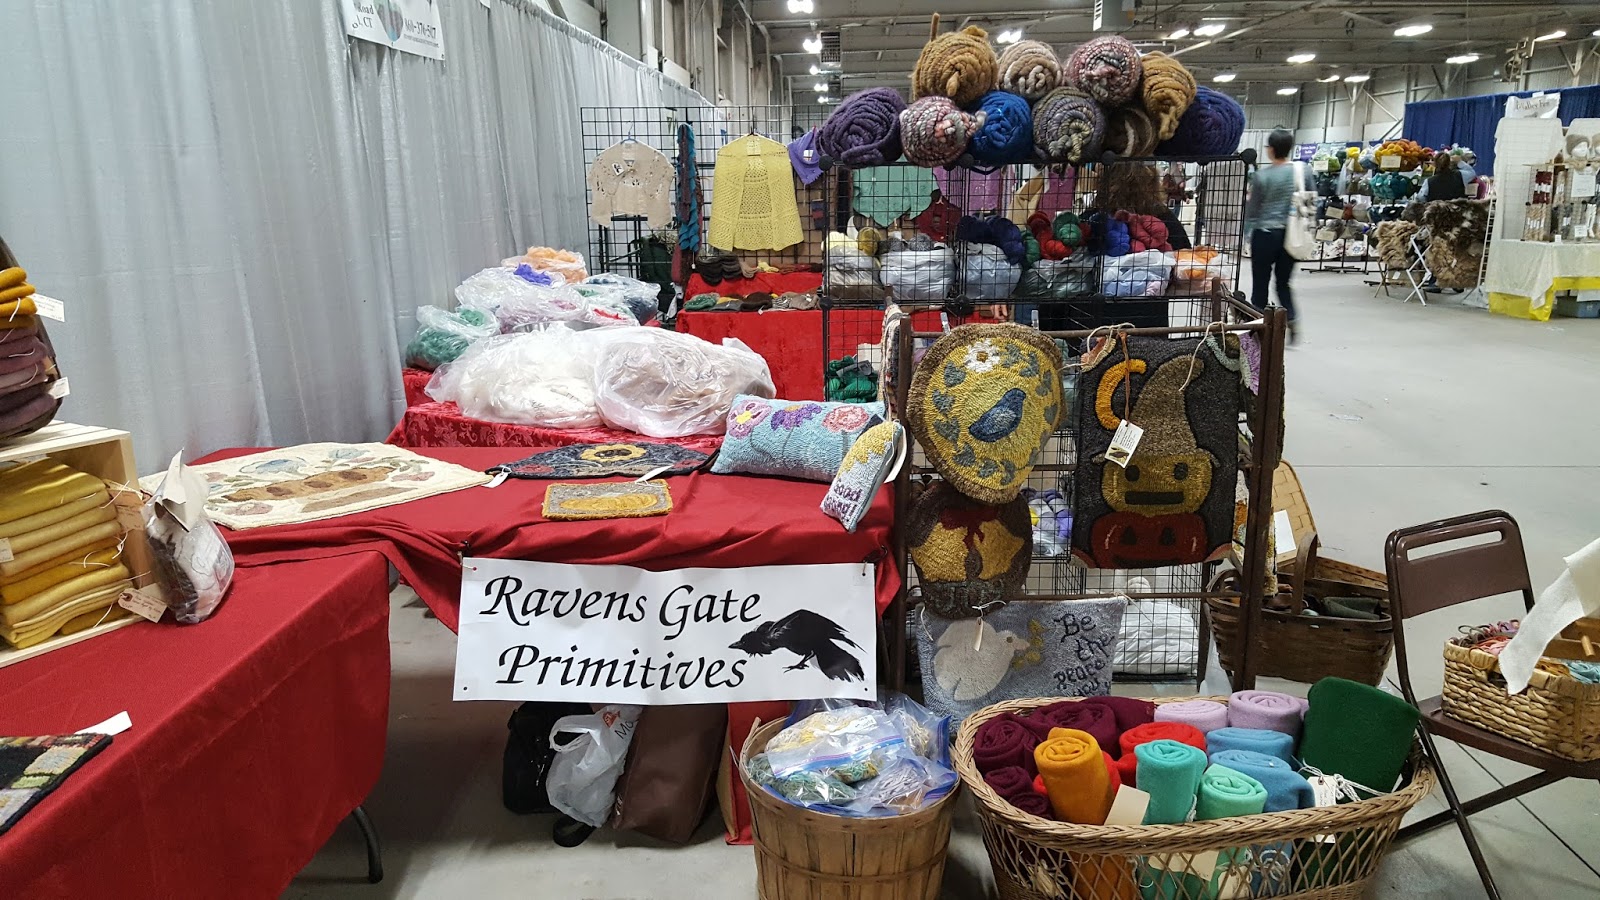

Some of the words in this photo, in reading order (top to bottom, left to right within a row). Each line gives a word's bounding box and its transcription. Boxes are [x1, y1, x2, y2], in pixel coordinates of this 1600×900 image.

[479, 575, 648, 627] Ravens
[659, 584, 763, 641] Gate
[1053, 613, 1096, 643] Be
[496, 643, 748, 690] Primitives
